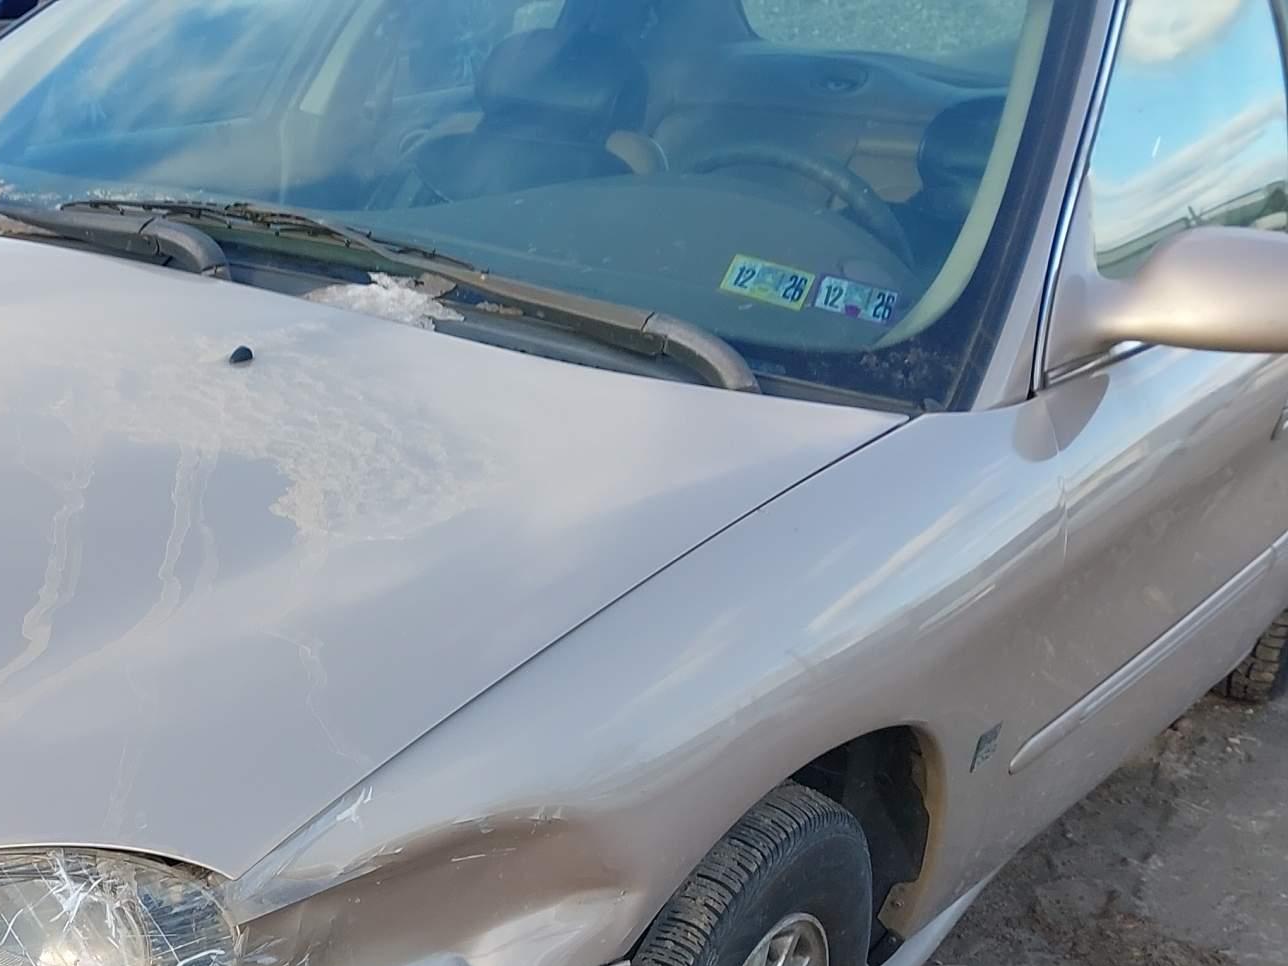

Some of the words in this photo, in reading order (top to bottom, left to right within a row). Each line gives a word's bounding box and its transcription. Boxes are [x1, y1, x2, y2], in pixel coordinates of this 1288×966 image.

[733, 265, 757, 289] 12
[782, 274, 807, 301] 26
[823, 285, 844, 309] 12
[872, 292, 896, 320] 26
